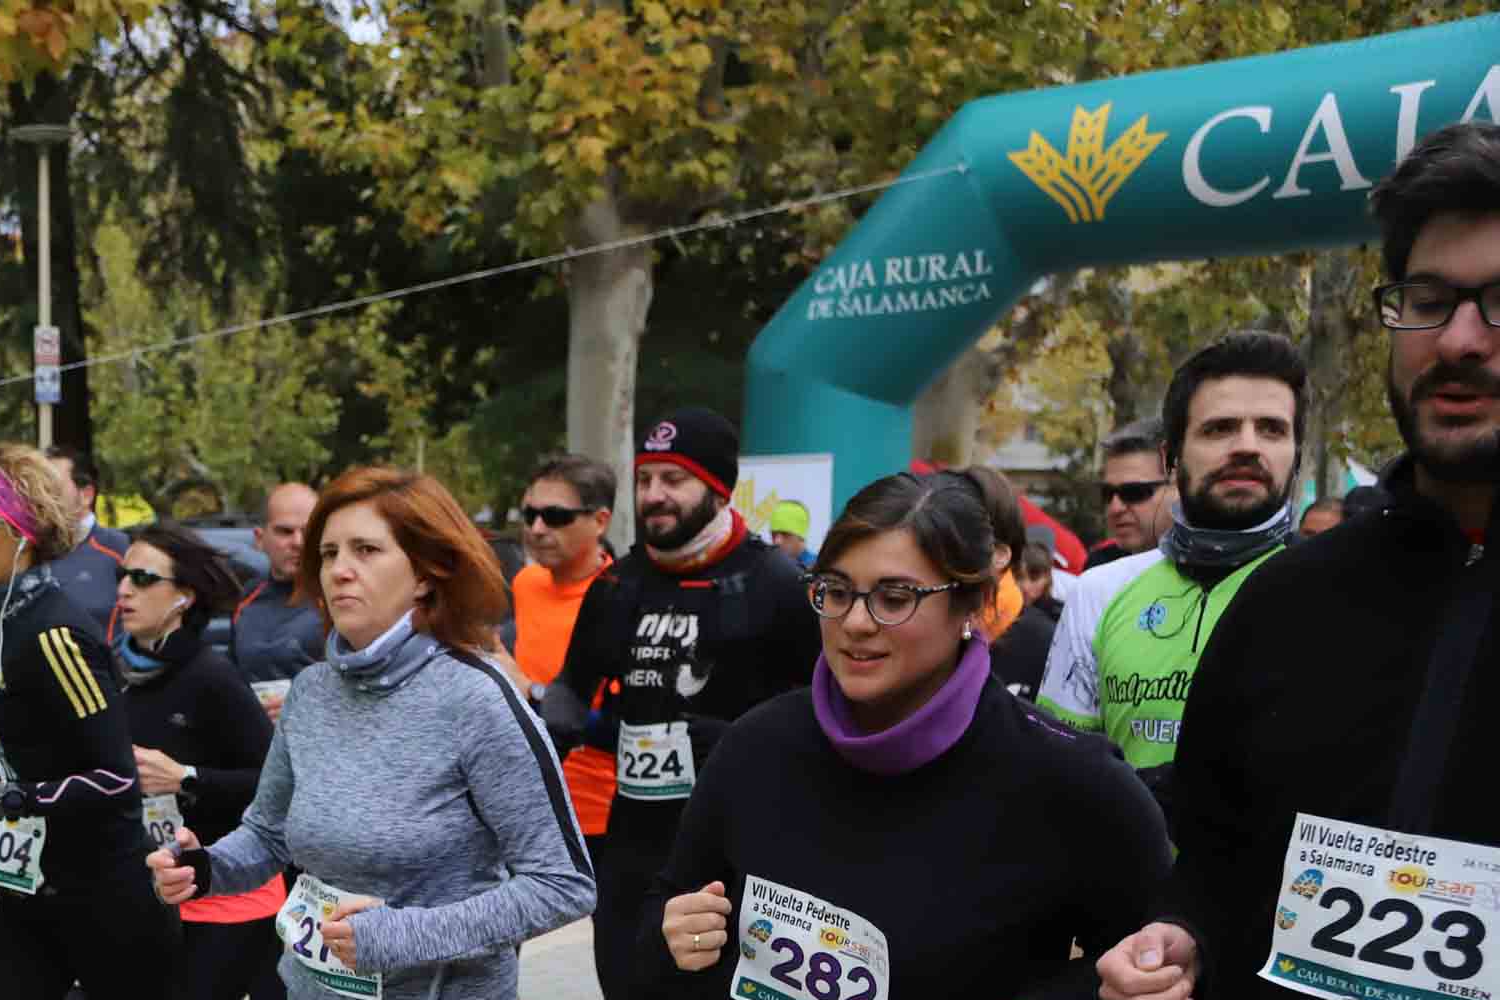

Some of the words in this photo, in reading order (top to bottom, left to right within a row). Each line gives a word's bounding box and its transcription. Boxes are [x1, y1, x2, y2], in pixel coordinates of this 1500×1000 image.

[884, 249, 992, 286] RURAL
[836, 281, 991, 318] SALAMANCA
[624, 750, 684, 780] 224
[1299, 821, 1316, 844] VII
[1319, 826, 1364, 854] Vuelta
[1365, 836, 1438, 867] Pedestre
[1299, 850, 1307, 863] a
[1309, 848, 1376, 878] Salamanca
[752, 881, 767, 900] VII
[768, 887, 804, 913] Vuelta
[806, 900, 851, 931] Pedestre
[762, 902, 813, 932] Salamanca
[1311, 886, 1487, 981] 223
[1297, 966, 1326, 988] CAJA
[1364, 984, 1387, 1000] DE
